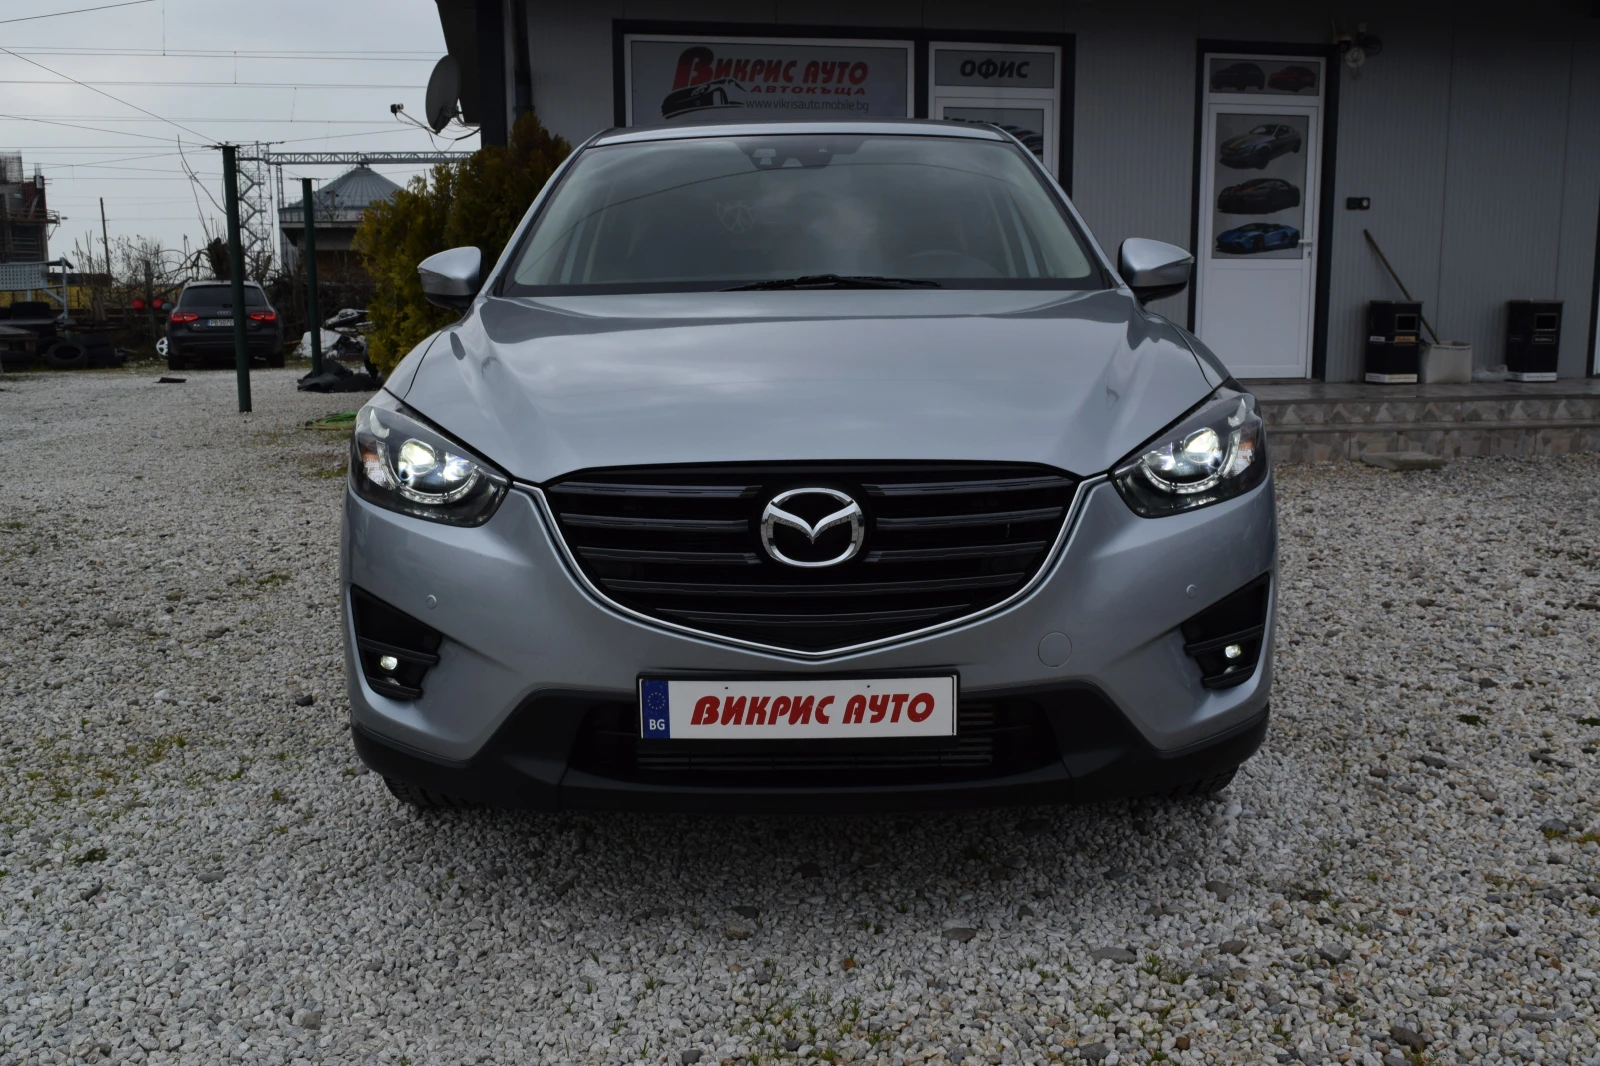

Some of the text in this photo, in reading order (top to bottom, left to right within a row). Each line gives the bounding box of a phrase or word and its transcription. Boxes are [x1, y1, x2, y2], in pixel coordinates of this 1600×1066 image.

[672, 46, 869, 91] ВИКРИС АУТО
[960, 58, 1030, 79] ОФИС
[750, 85, 866, 96] АВТОКЪЩА
[746, 98, 869, 112] www.vikrisauto.mobile.bg
[690, 692, 935, 726] ВИКРИС АУТО
[649, 719, 665, 730] BG
